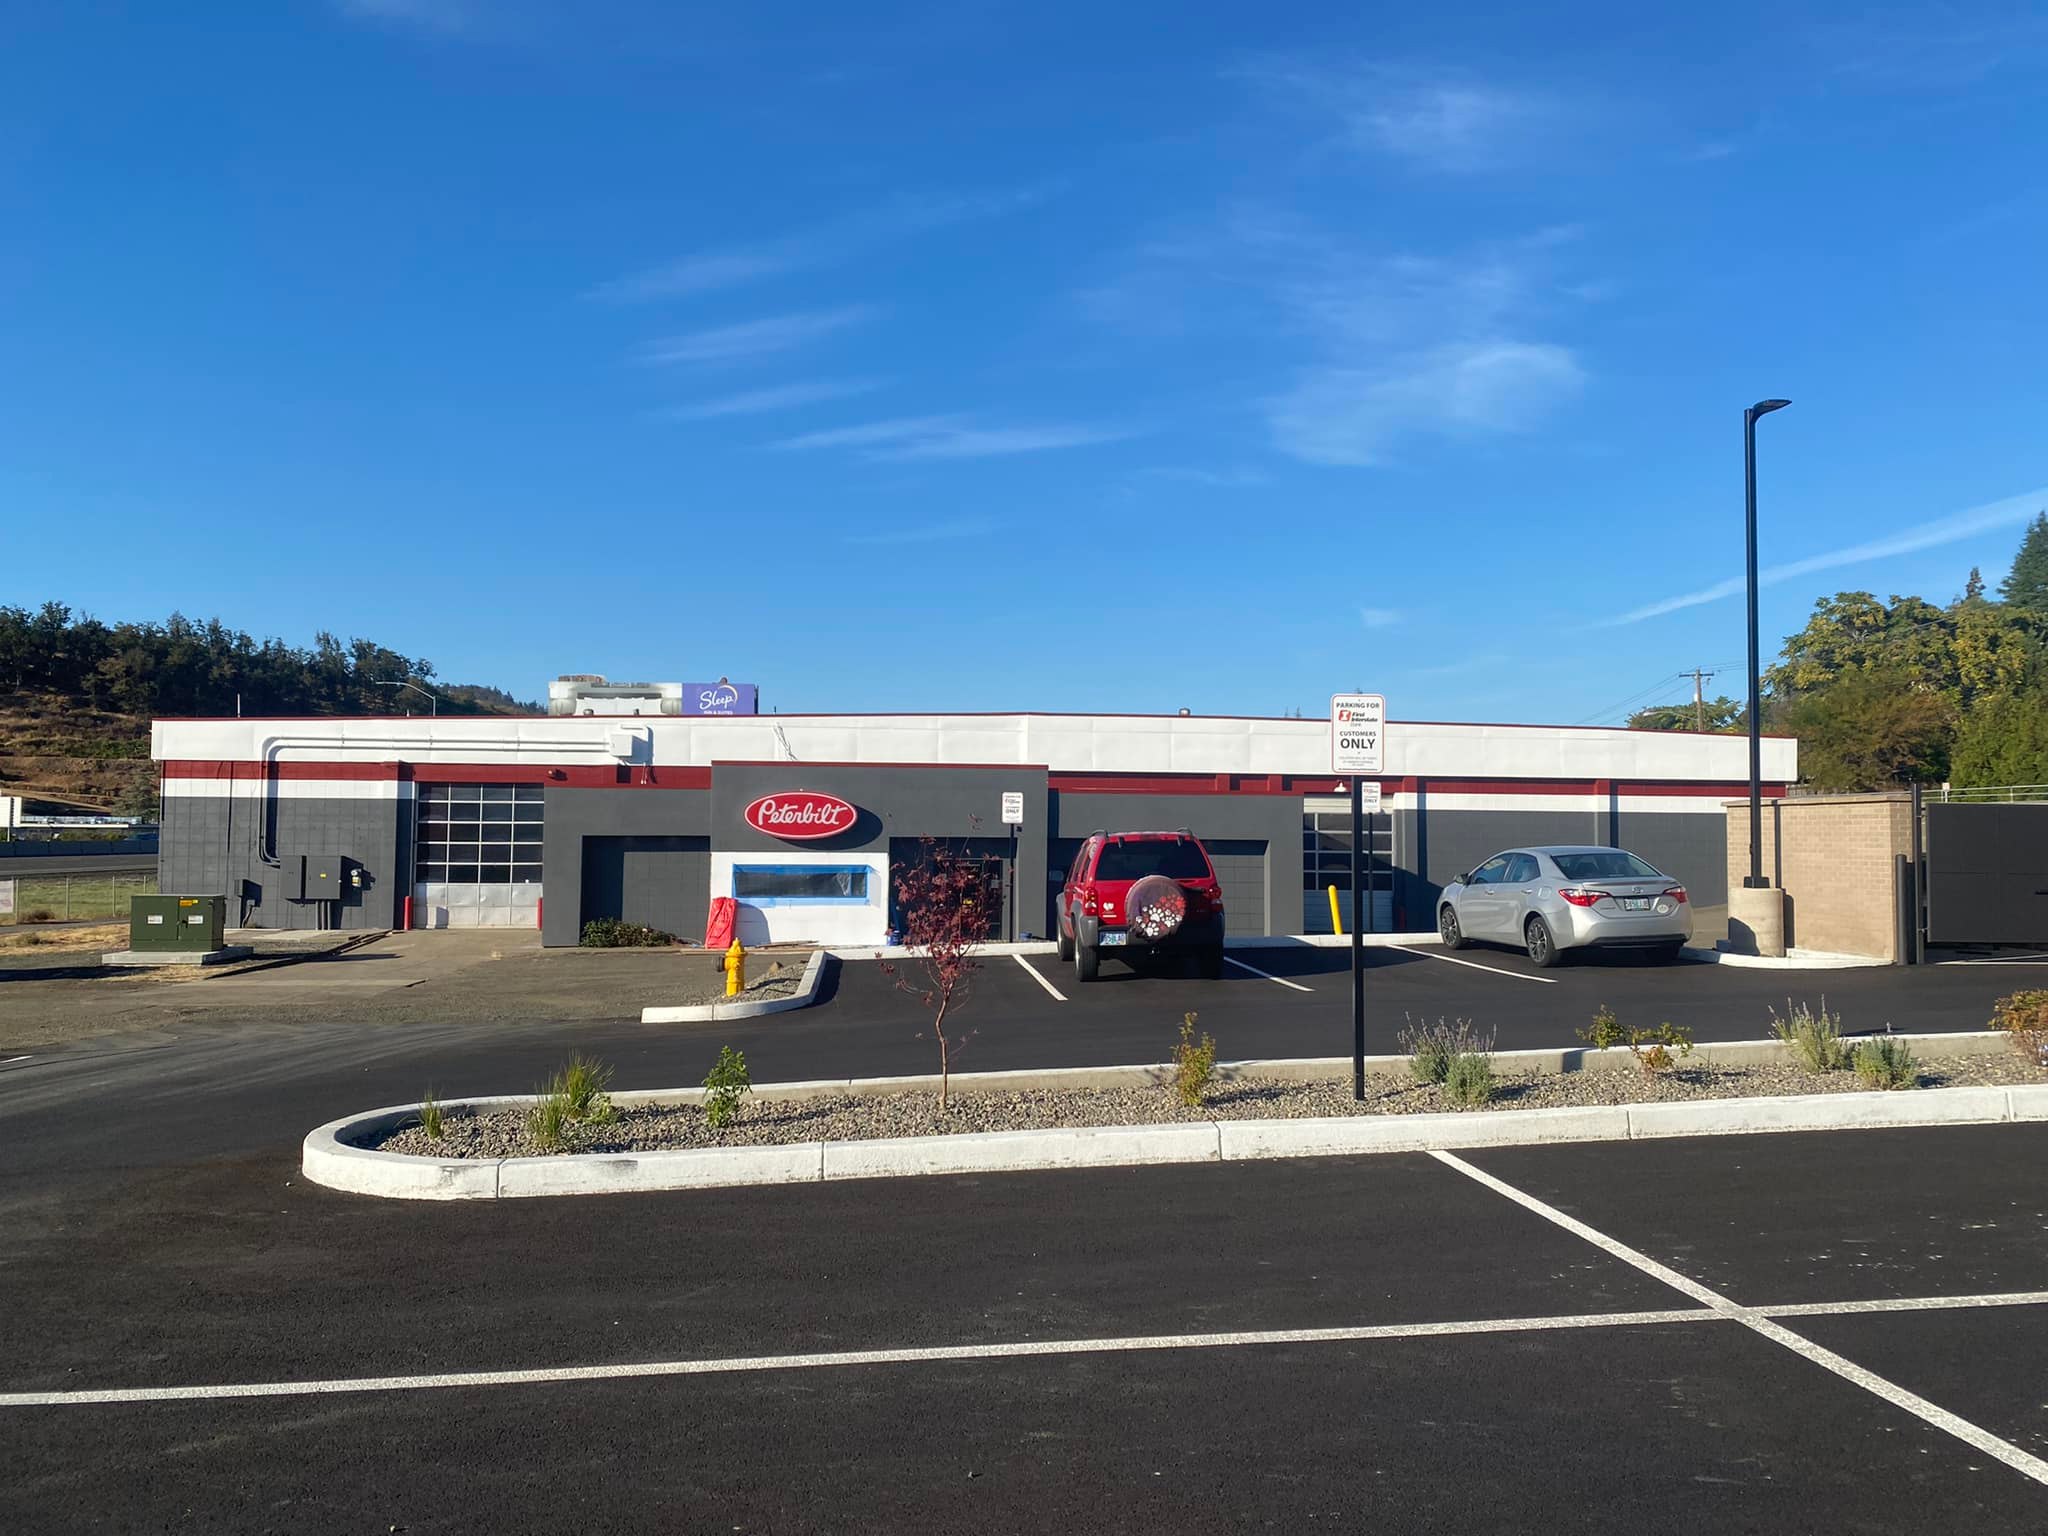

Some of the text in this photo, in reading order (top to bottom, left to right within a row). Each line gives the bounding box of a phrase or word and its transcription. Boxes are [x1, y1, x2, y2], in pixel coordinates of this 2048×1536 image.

[700, 690, 735, 710] Sleep
[1340, 738, 1376, 749] ONLY
[758, 799, 848, 826] Peterbilt
